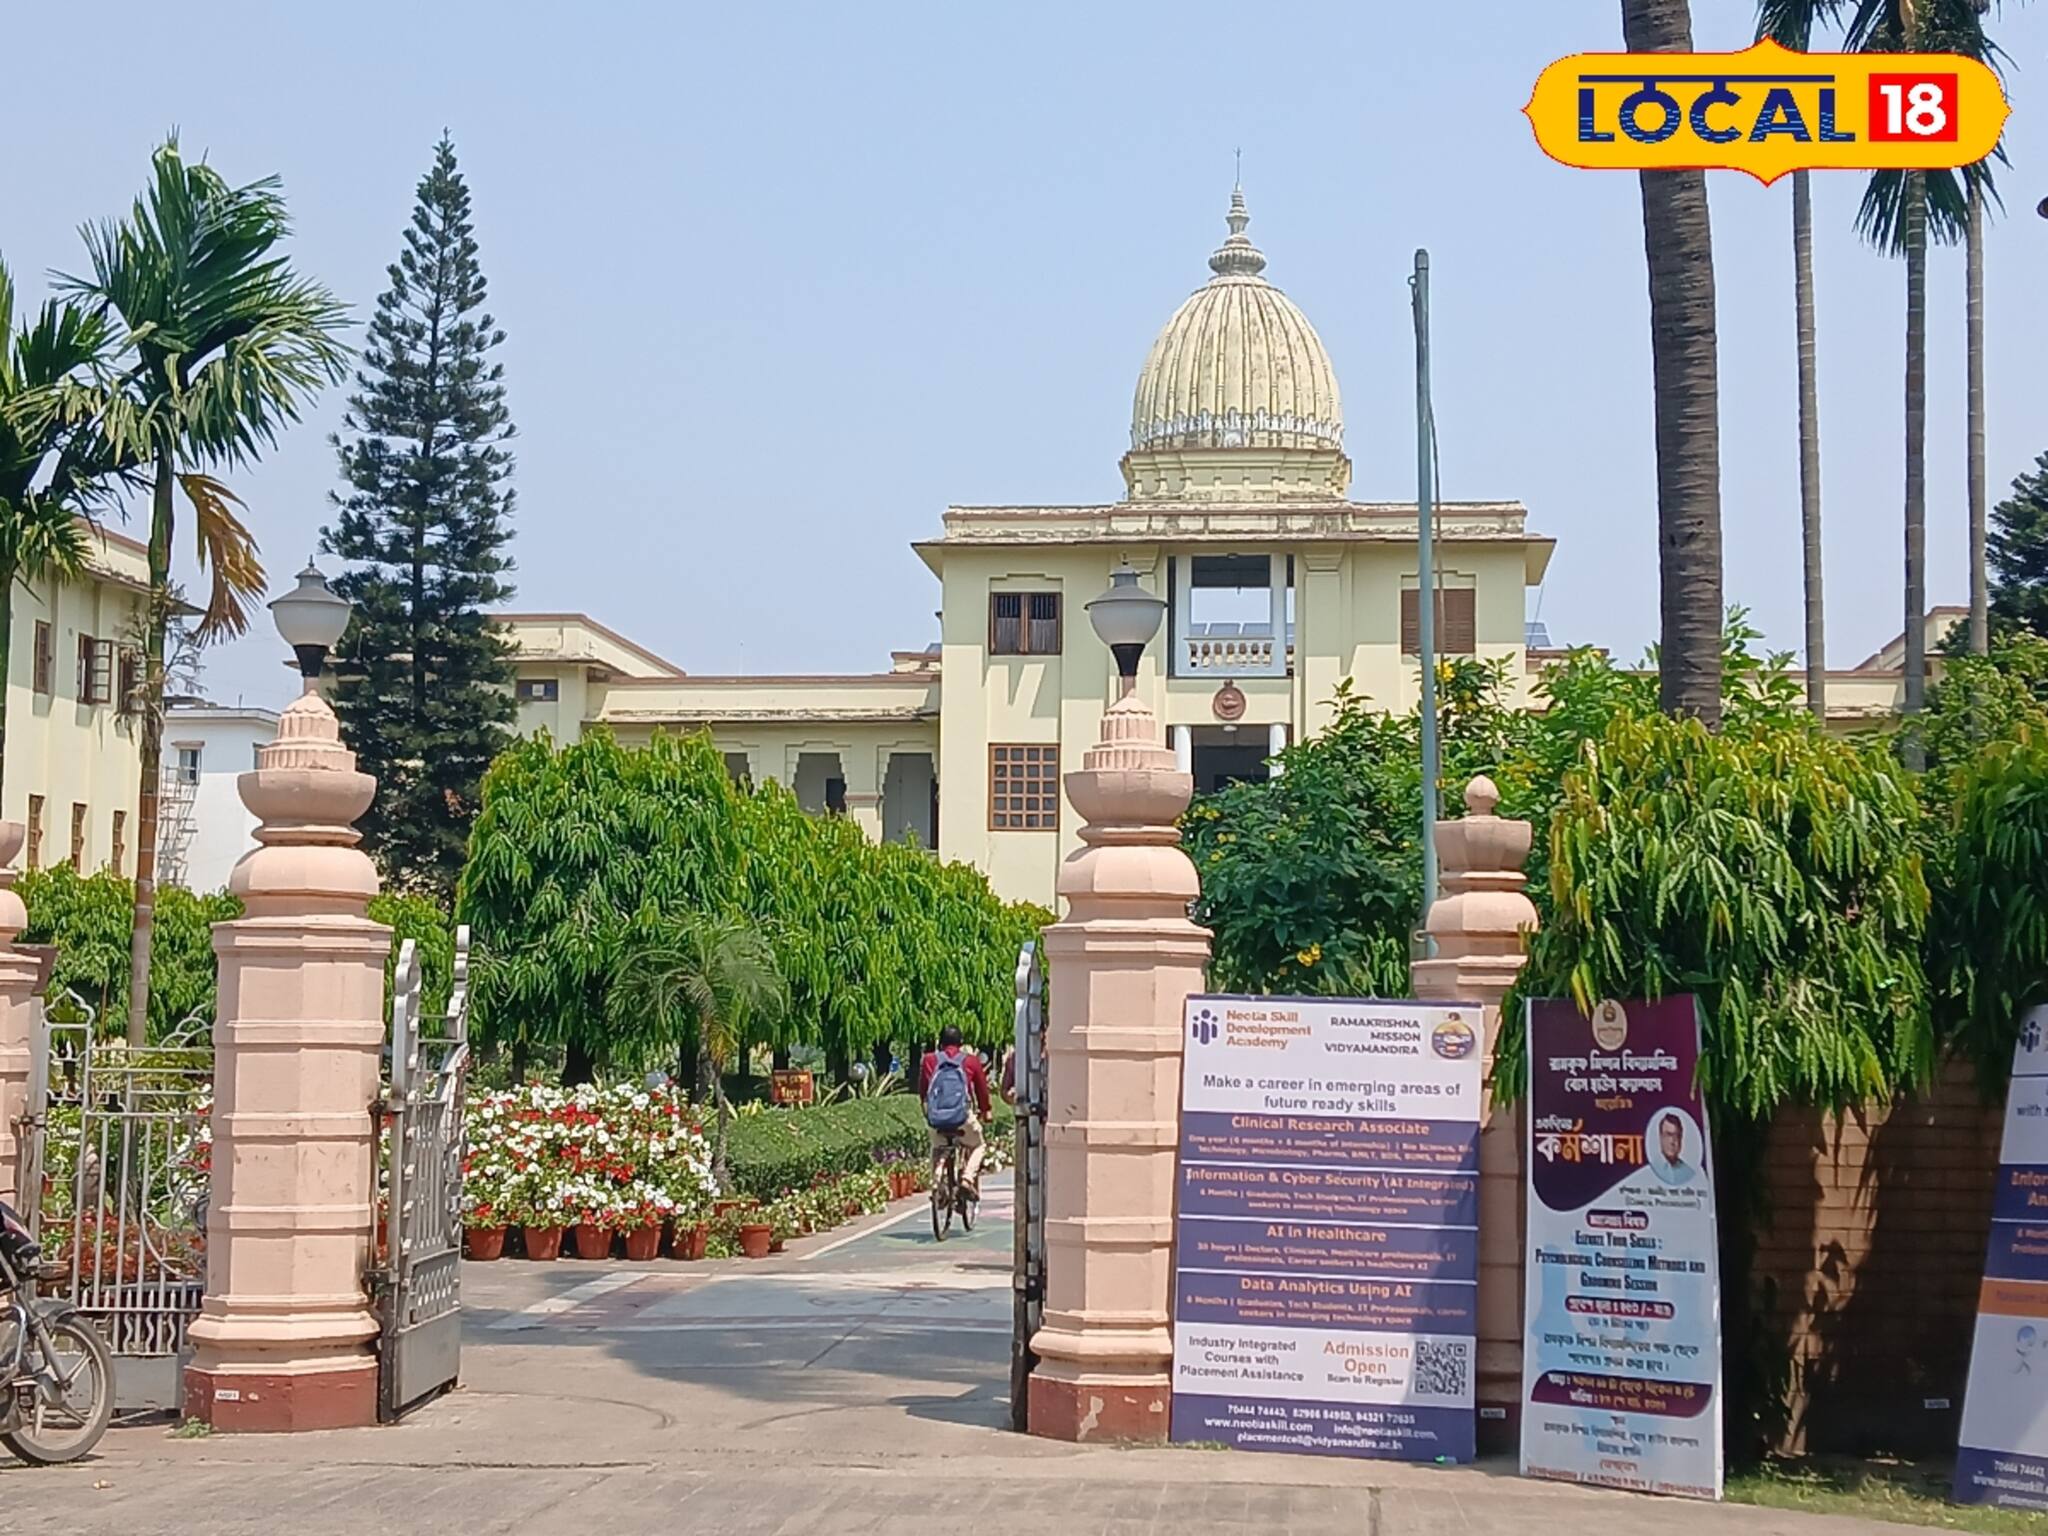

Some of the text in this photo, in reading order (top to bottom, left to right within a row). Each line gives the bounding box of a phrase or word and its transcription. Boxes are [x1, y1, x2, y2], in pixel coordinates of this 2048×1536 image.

[1271, 1011, 1298, 1022] Skill
[1331, 1017, 1420, 1028] RAMAKRISHNA
[1227, 1022, 1311, 1036] Development
[1371, 1032, 1420, 1042] MISSION
[1227, 1036, 1288, 1049] Academy
[1325, 1043, 1419, 1054] VIDYAMANDIRA
[1203, 1075, 1460, 1096] Make a career in emerging areas of
[1264, 1096, 1396, 1113] future ready skills
[1232, 1116, 1430, 1135] Clinical Research Associate
[1535, 1118, 1644, 1165] কর্মশালা
[1186, 1168, 1264, 1183] Information
[1268, 1171, 1279, 1183] &
[1282, 1172, 1322, 1186] Cyber
[1325, 1174, 1380, 1189] Security
[1407, 1178, 1474, 1192] Integrated)
[1266, 1225, 1387, 1242] AI in Healthcare
[1241, 1278, 1412, 1298] Data Analytics Using AI
[1189, 1336, 1297, 1352] Industry Integrated
[1323, 1340, 1409, 1358] Admission
[1204, 1351, 1279, 1365] Courses with
[1344, 1358, 1387, 1375] Open
[1180, 1364, 1304, 1381] Placement Assistance
[1327, 1374, 1350, 1383] Scan
[1365, 1376, 1404, 1387] Register
